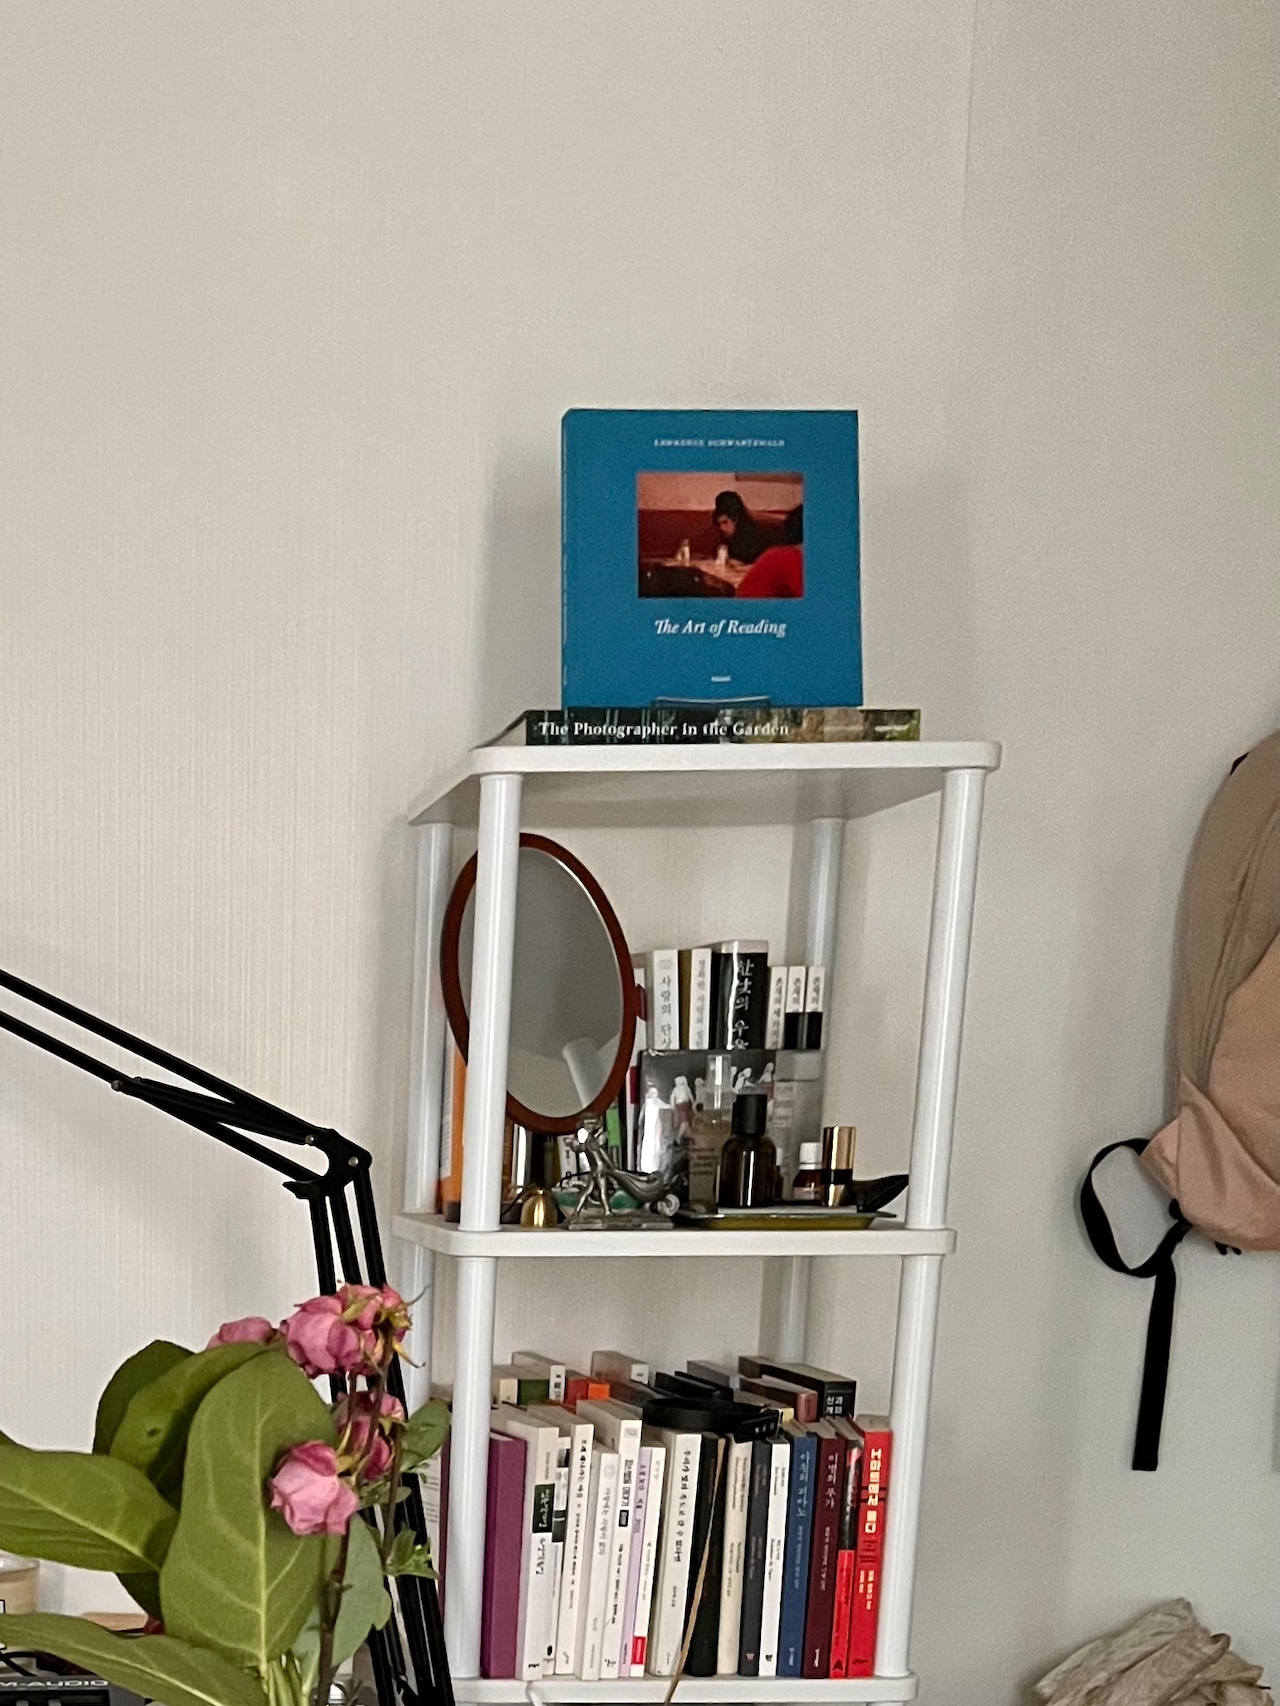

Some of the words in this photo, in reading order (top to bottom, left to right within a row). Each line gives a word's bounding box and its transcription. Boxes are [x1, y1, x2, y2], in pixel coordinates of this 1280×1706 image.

[654, 618, 680, 635] The
[681, 619, 706, 635] Art
[708, 619, 727, 638] of
[727, 618, 787, 639] Reading
[538, 721, 569, 736] The
[573, 721, 678, 739] Photographer
[681, 721, 698, 736] in
[703, 721, 729, 736] the
[732, 721, 789, 737] Garden
